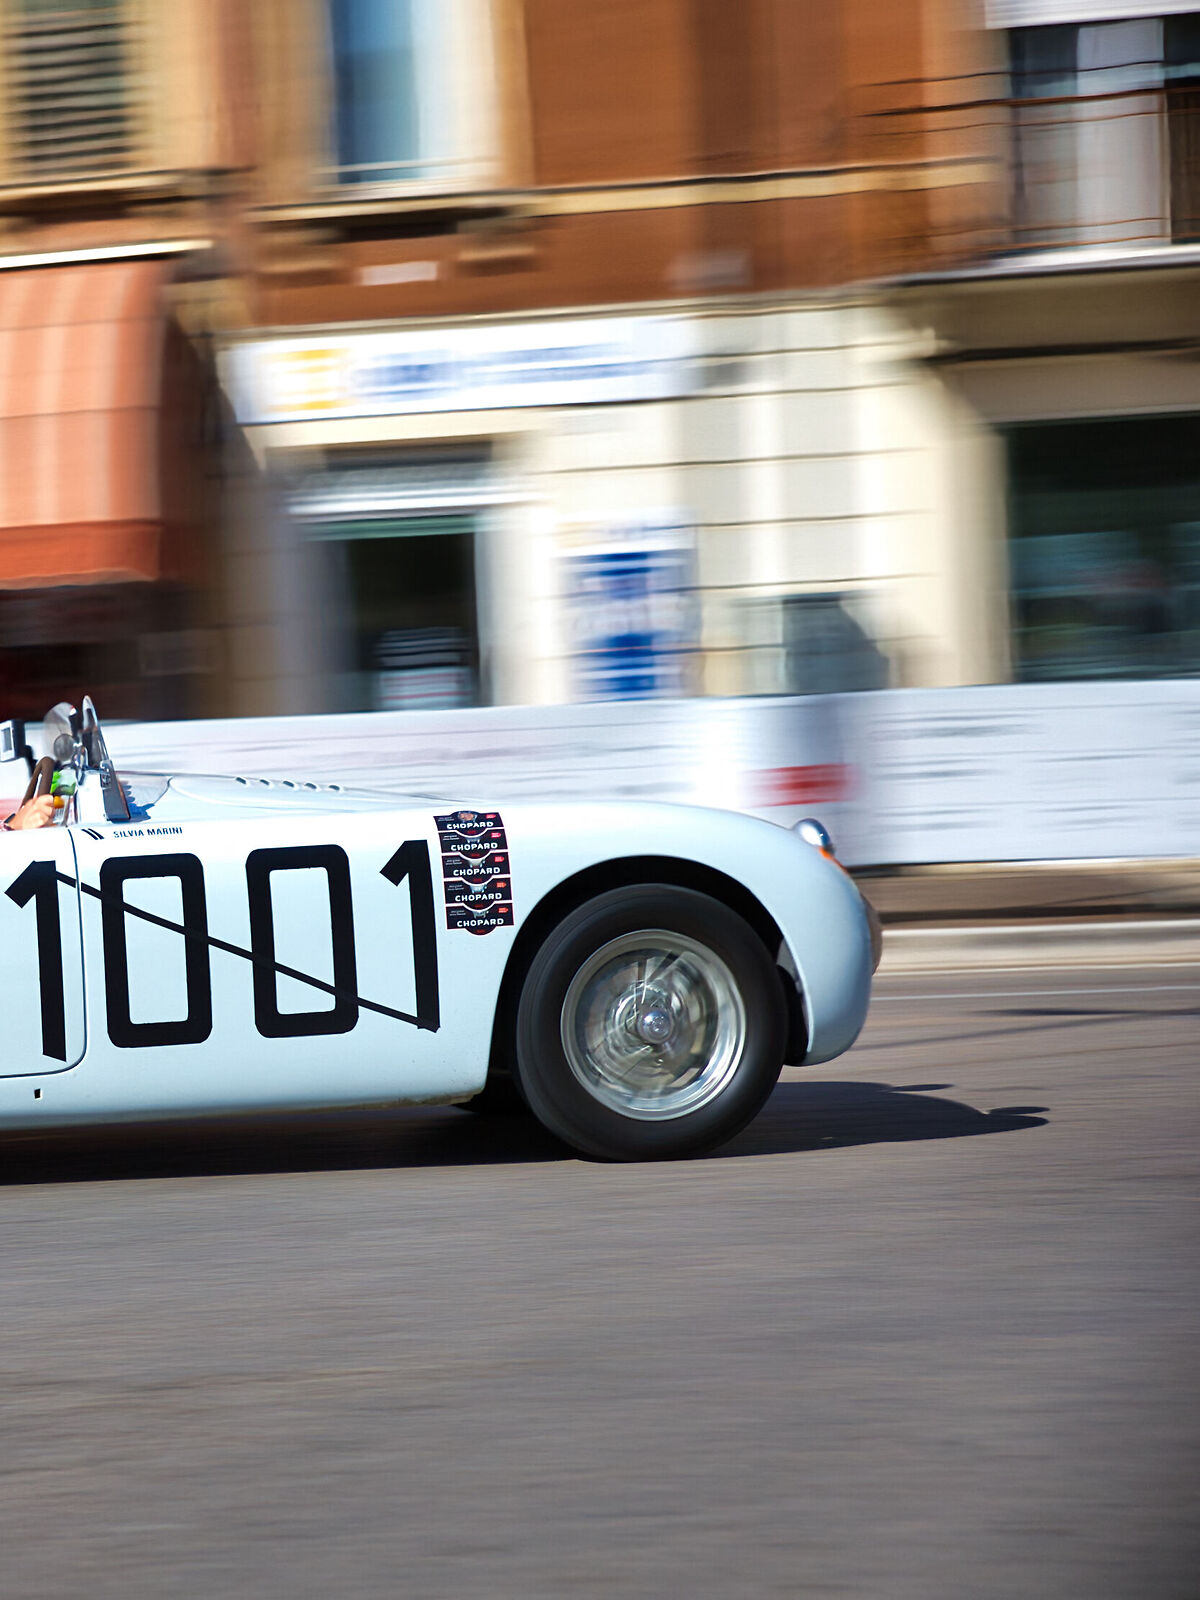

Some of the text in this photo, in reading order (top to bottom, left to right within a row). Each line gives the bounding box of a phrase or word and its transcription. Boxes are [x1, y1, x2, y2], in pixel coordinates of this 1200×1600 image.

[446, 821, 494, 830] CHOPARD
[113, 826, 183, 838] SILVIA MARINI
[451, 842, 498, 851] CHOPARD
[453, 867, 500, 876] CHOPARD
[455, 892, 502, 902] CHOPARD
[456, 918, 504, 927] CHOPARD
[4, 839, 440, 1062] 1001
